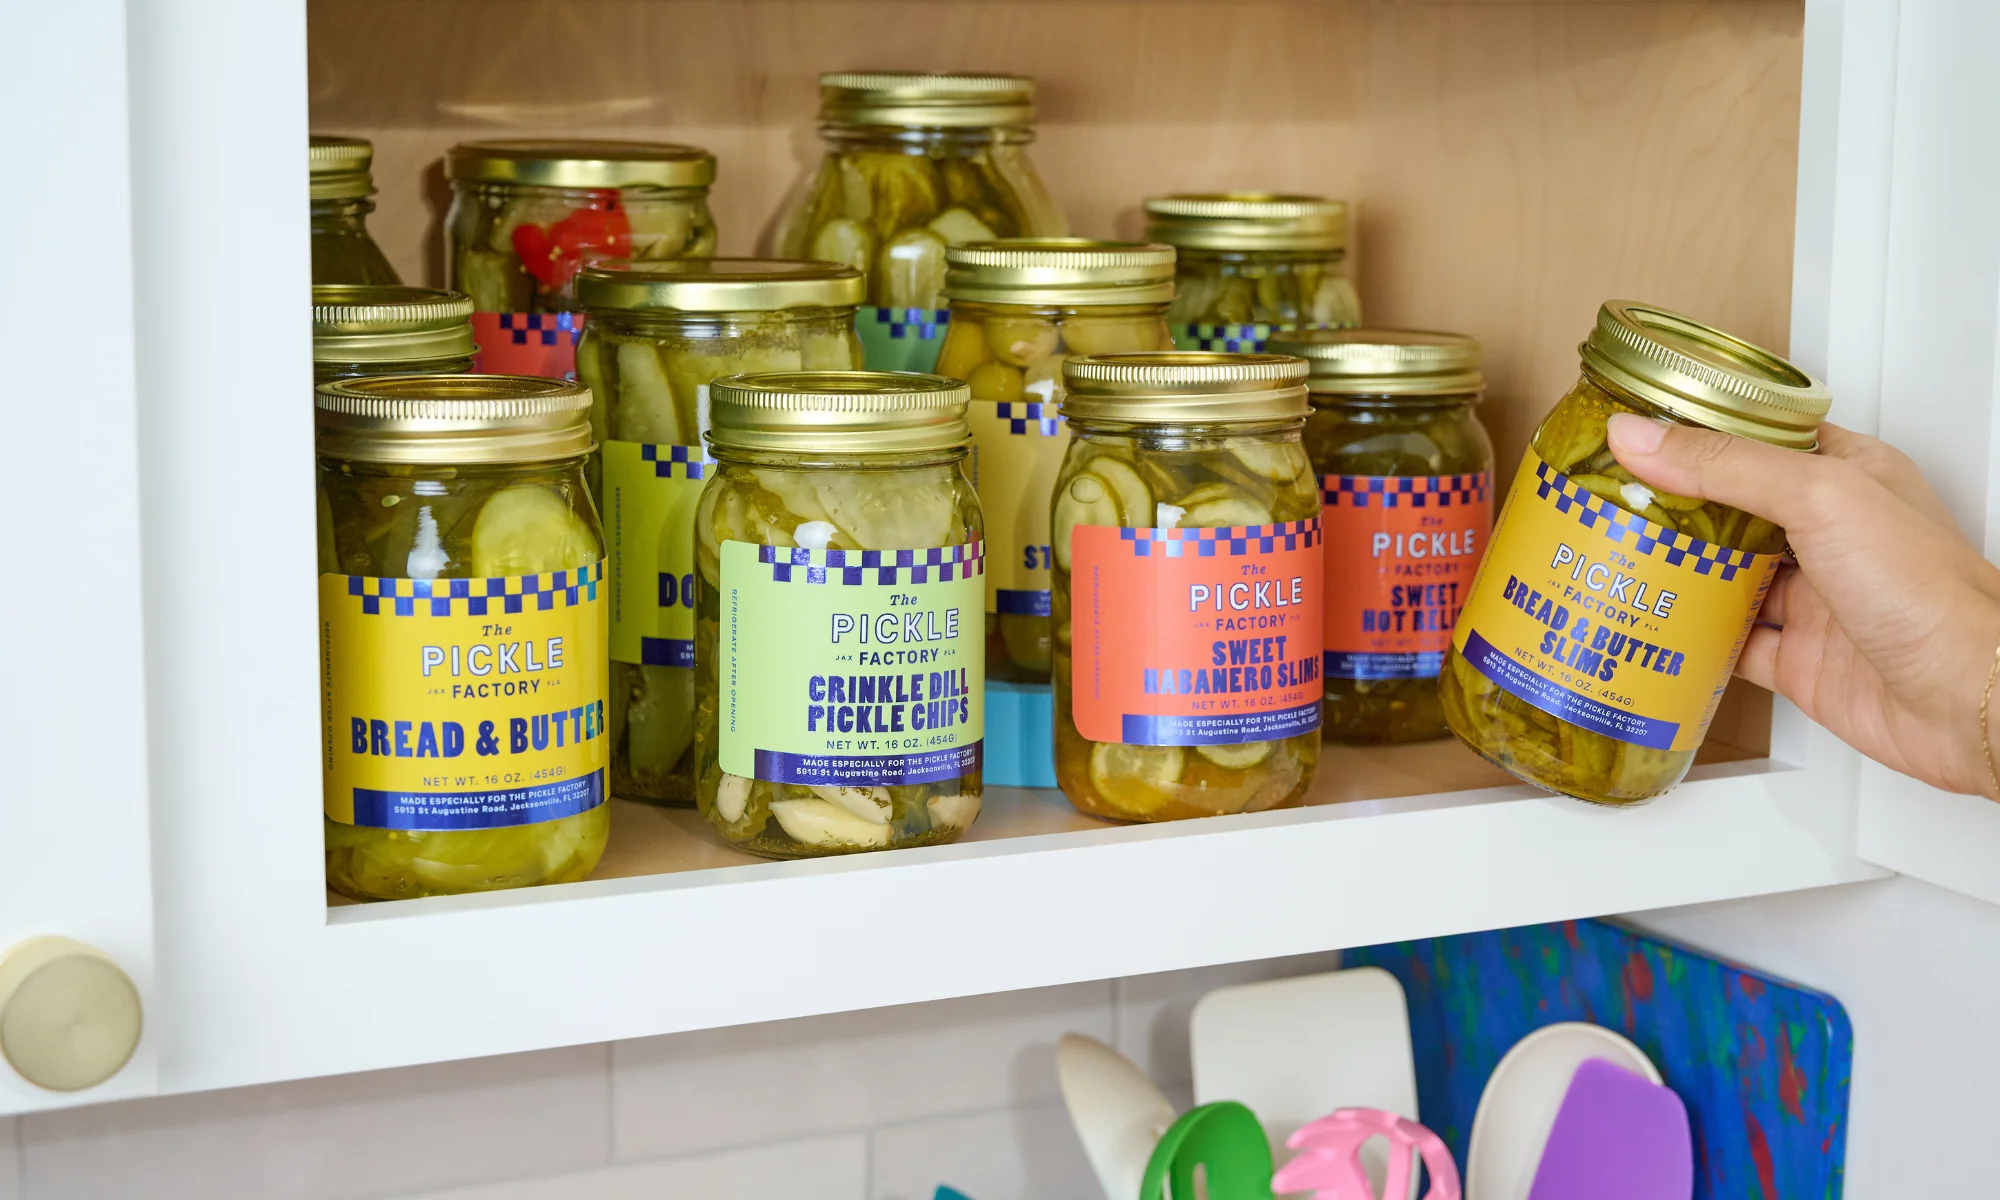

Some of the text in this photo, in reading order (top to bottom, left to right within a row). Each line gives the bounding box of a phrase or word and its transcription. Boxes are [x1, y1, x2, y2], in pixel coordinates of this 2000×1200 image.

[1372, 528, 1476, 559] PICKLE
[1241, 564, 1266, 575] The
[1395, 563, 1459, 577] FACTORY
[1607, 550, 1636, 570] The
[1189, 576, 1303, 613] PICKLE
[1550, 543, 1678, 619] PICKLE
[890, 593, 917, 606] The
[1391, 582, 1459, 608] SWEET
[1547, 578, 1659, 633] JAX FACTORY FLA
[482, 623, 513, 637] The
[831, 608, 959, 644] PICKLE
[1215, 613, 1286, 631] FACTORY
[1363, 606, 1462, 633] HOT RELI
[1503, 574, 1685, 677] BREAD & BUTTER
[421, 637, 563, 677] PICKLE
[859, 648, 939, 666] FACTORY
[1211, 636, 1287, 666] SWEET
[1539, 630, 1618, 682] SLIMS
[808, 667, 969, 704] CRINKLE DILL
[1144, 655, 1319, 694] HABANERO SLIMS
[1514, 647, 1635, 708] NET WT. 16 OZ. (454G)
[452, 679, 541, 699] FACTORY
[1482, 655, 1649, 737] 5913 St Augustine Road, Jacksonville, FL 32207
[1489, 651, 1647, 728] MADE ESPECIALLY FOR THE PICKLE FACTORY
[808, 696, 969, 733] PICKLE CHIPS
[1192, 701, 1214, 711] NET
[1220, 699, 1239, 709] WT.
[1244, 698, 1257, 707] 16
[1260, 696, 1276, 705] OZ.
[351, 699, 605, 758] BREAD & BUTTER
[1197, 718, 1244, 727] ESPECIALLY
[1245, 717, 1261, 725] FOR
[1278, 711, 1297, 721] PICKLE
[1198, 728, 1239, 737] Augustine
[1241, 725, 1262, 734] Road,
[827, 733, 957, 750] NET WT. 16 OZ. (454G)
[796, 767, 817, 775] 5913
[820, 768, 830, 776] St
[833, 769, 879, 778] Augustine
[882, 767, 905, 777] Road,
[907, 763, 953, 775] Jacksonville,
[954, 761, 961, 769] FL
[803, 748, 973, 768] MADE ESPECIALLY FOR THE PICKLE FACTORY
[400, 780, 586, 805] MADE ESPECIALLY FOR THE PICKLE FACTORY
[423, 776, 448, 787] NET
[454, 775, 479, 786] WT.
[484, 774, 499, 785] 16
[504, 772, 525, 783] OZ.
[394, 789, 590, 816] 5913 St Augustine Road, Jacksonville, FL 32207
